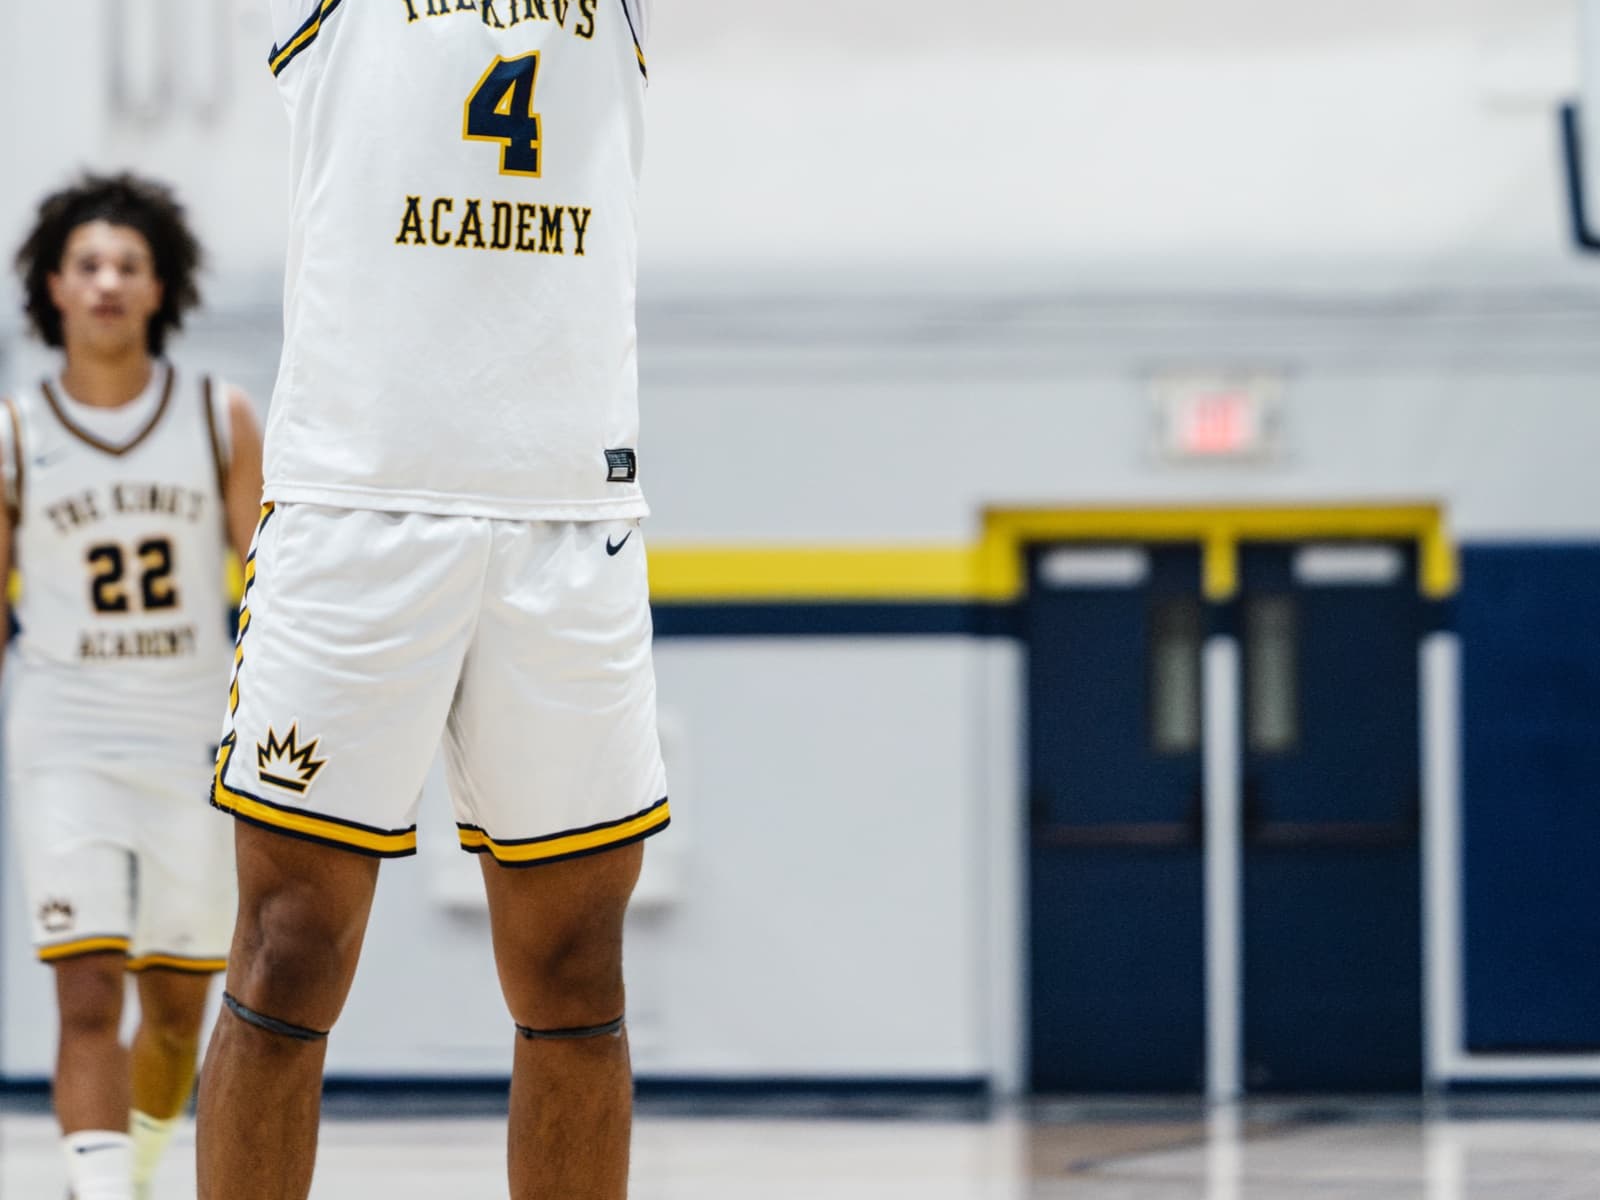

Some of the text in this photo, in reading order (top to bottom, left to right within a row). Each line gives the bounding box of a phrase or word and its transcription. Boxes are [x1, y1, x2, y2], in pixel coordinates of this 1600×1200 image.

[462, 49, 542, 178] 4
[395, 195, 592, 256] ACADEMY
[86, 536, 180, 614] 22
